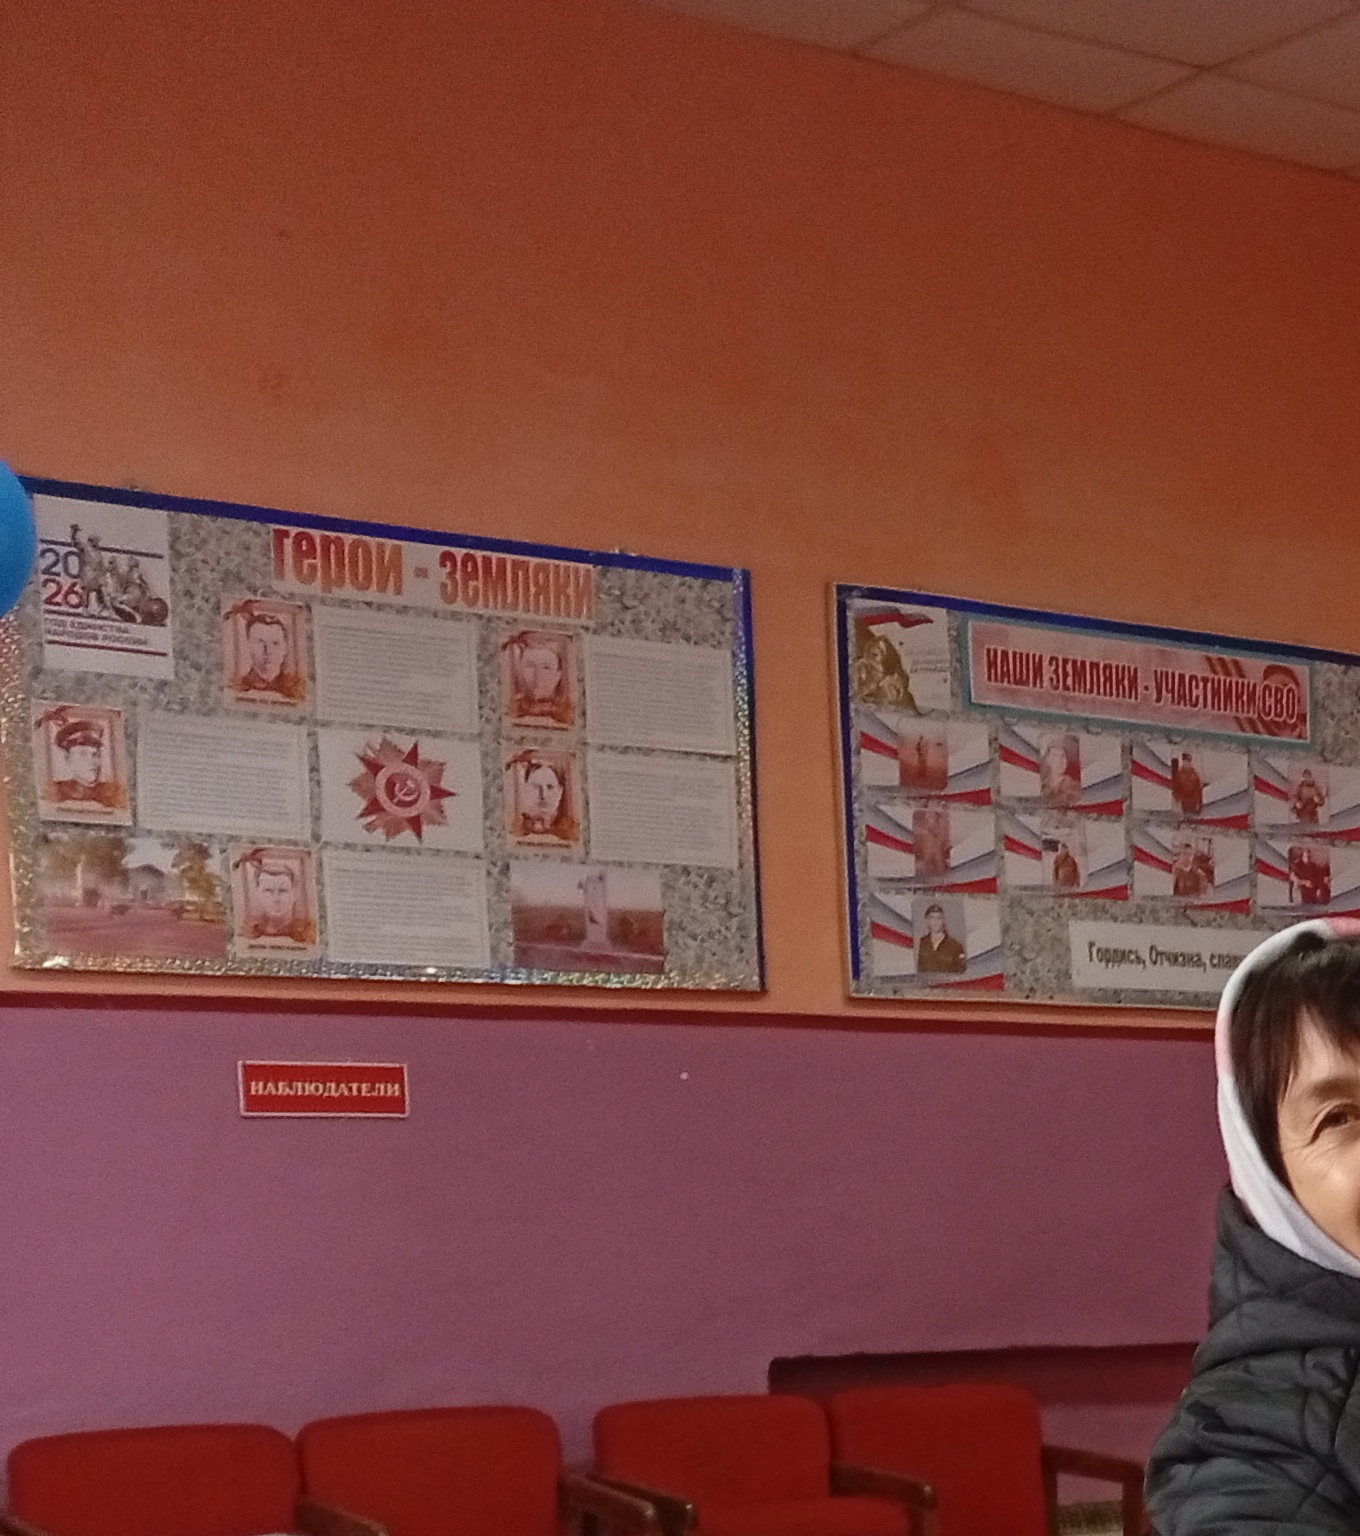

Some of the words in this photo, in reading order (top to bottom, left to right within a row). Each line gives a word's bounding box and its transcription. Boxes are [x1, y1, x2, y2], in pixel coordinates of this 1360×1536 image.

[273, 528, 403, 595] герои
[438, 550, 593, 620] земляки
[985, 648, 1044, 689] НАШИ
[1049, 656, 1139, 700] ЗЕМЛЯКИ
[1154, 669, 1257, 717] УЧАСТНИКИ
[1260, 682, 1298, 723] СВО
[250, 1081, 400, 1098] НАБЛЮДАТЕЛИ
